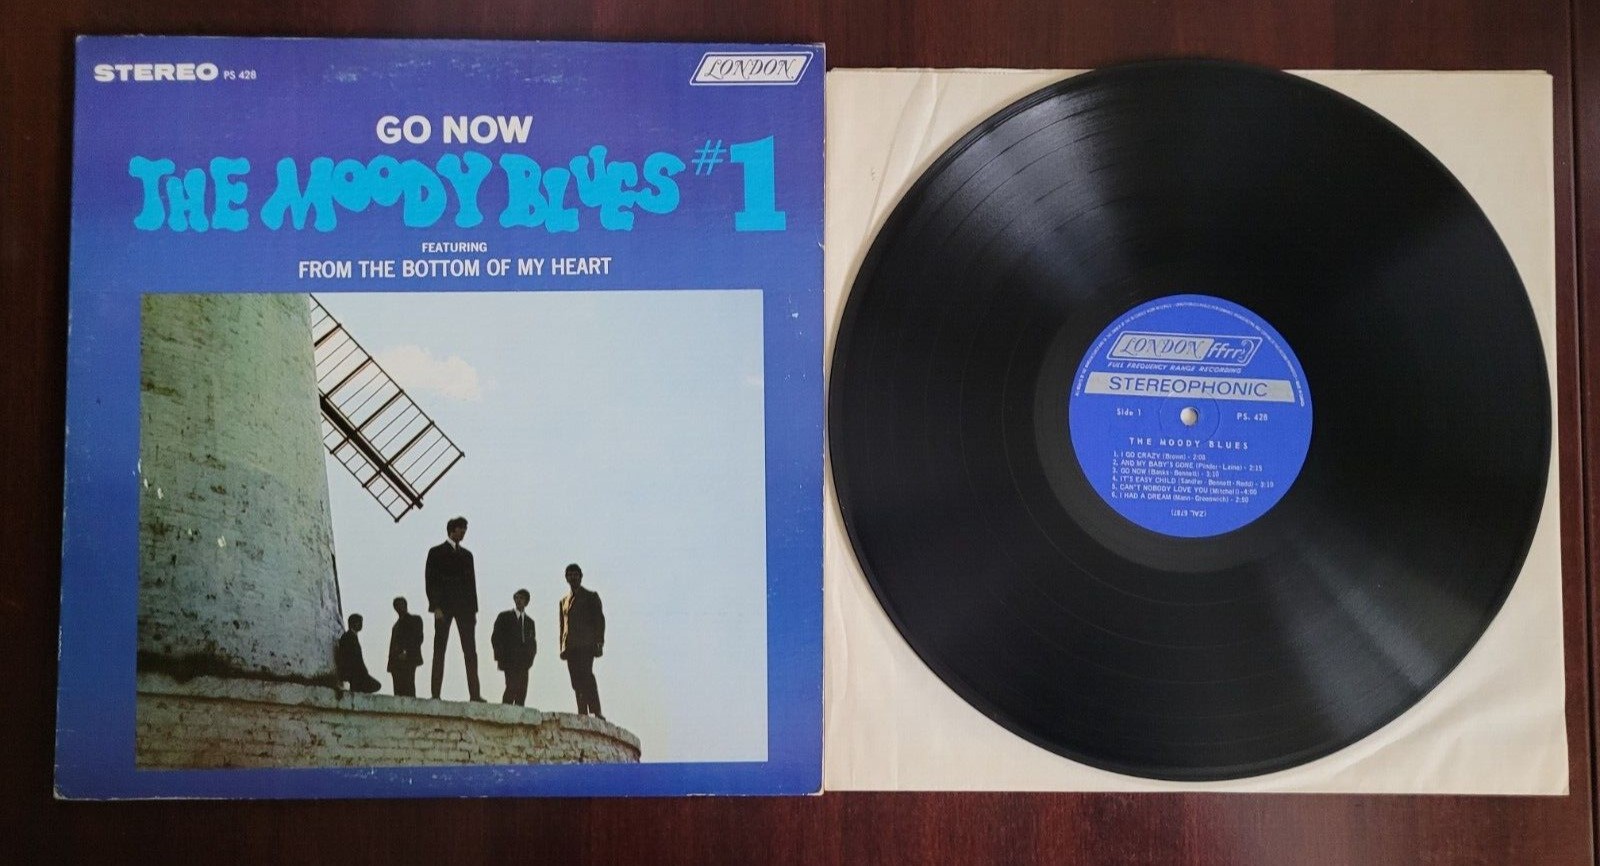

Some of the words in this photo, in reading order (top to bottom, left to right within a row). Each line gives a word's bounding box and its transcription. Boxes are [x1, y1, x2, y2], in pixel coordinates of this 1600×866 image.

[94, 63, 219, 82] STEREO
[224, 70, 236, 80] PS
[238, 70, 257, 80] 428
[376, 115, 432, 144] GO
[443, 115, 533, 144] NOW
[128, 155, 250, 232] THE
[260, 151, 493, 232] MOODY
[499, 144, 686, 233] BLUES
[422, 242, 487, 253] FEATURING
[299, 260, 352, 278] FROM
[358, 260, 396, 278] THE
[402, 259, 480, 277] BOTTOM
[486, 258, 511, 276] OF
[518, 258, 544, 276] MY
[552, 257, 612, 275] HEART
[1126, 362, 1167, 371] FREQUENCY
[1199, 366, 1242, 374] RECORDING
[1109, 376, 1268, 397] STEREOPHONIC
[1117, 408, 1134, 416] Side
[1137, 408, 1142, 416] 1
[1237, 412, 1251, 422] PS.
[1254, 413, 1268, 422] 428
[1129, 437, 1152, 445] THE
[1160, 438, 1200, 448] MOODY
[1209, 440, 1248, 450] BLUES
[1137, 452, 1161, 460] CRAZY
[1143, 484, 1171, 492] NOBODY
[1194, 486, 1208, 494] YOU
